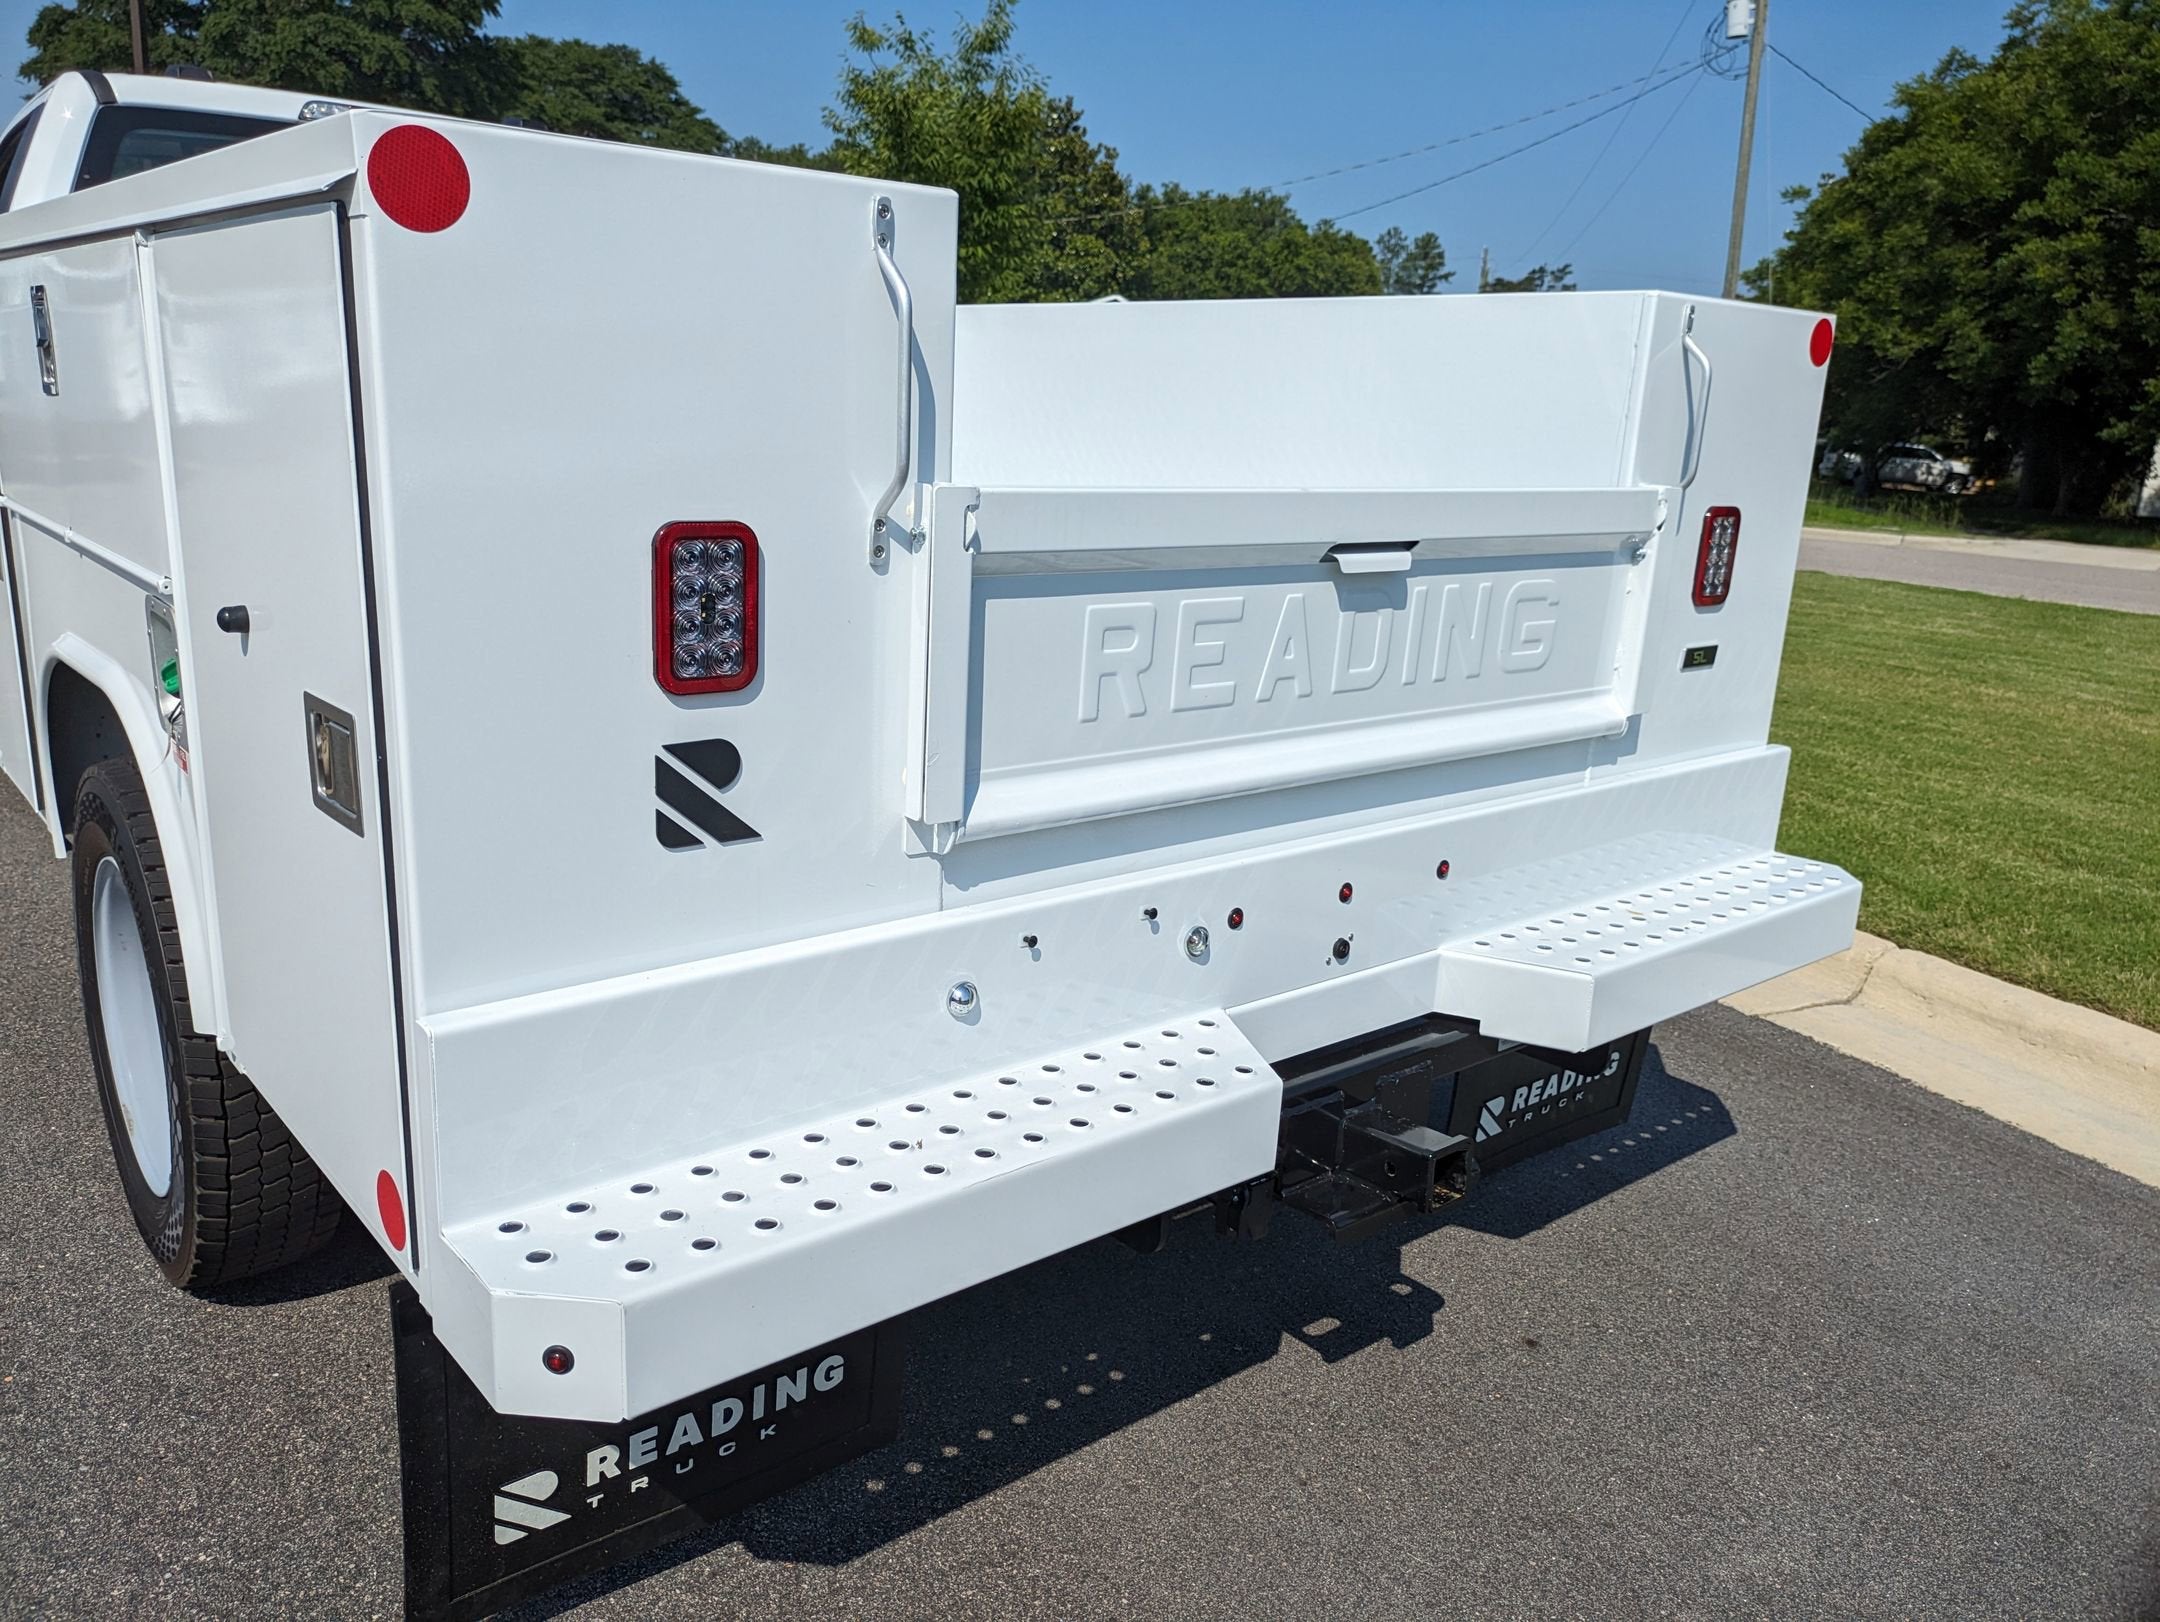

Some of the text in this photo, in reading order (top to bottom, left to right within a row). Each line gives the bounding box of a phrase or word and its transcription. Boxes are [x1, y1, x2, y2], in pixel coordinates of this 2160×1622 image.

[1079, 578, 1559, 723] READING
[1507, 1090, 1584, 1129] TRUCK
[1511, 1051, 1621, 1113] READIG
[586, 1354, 845, 1488] READING
[586, 1423, 777, 1509] TRUCK
